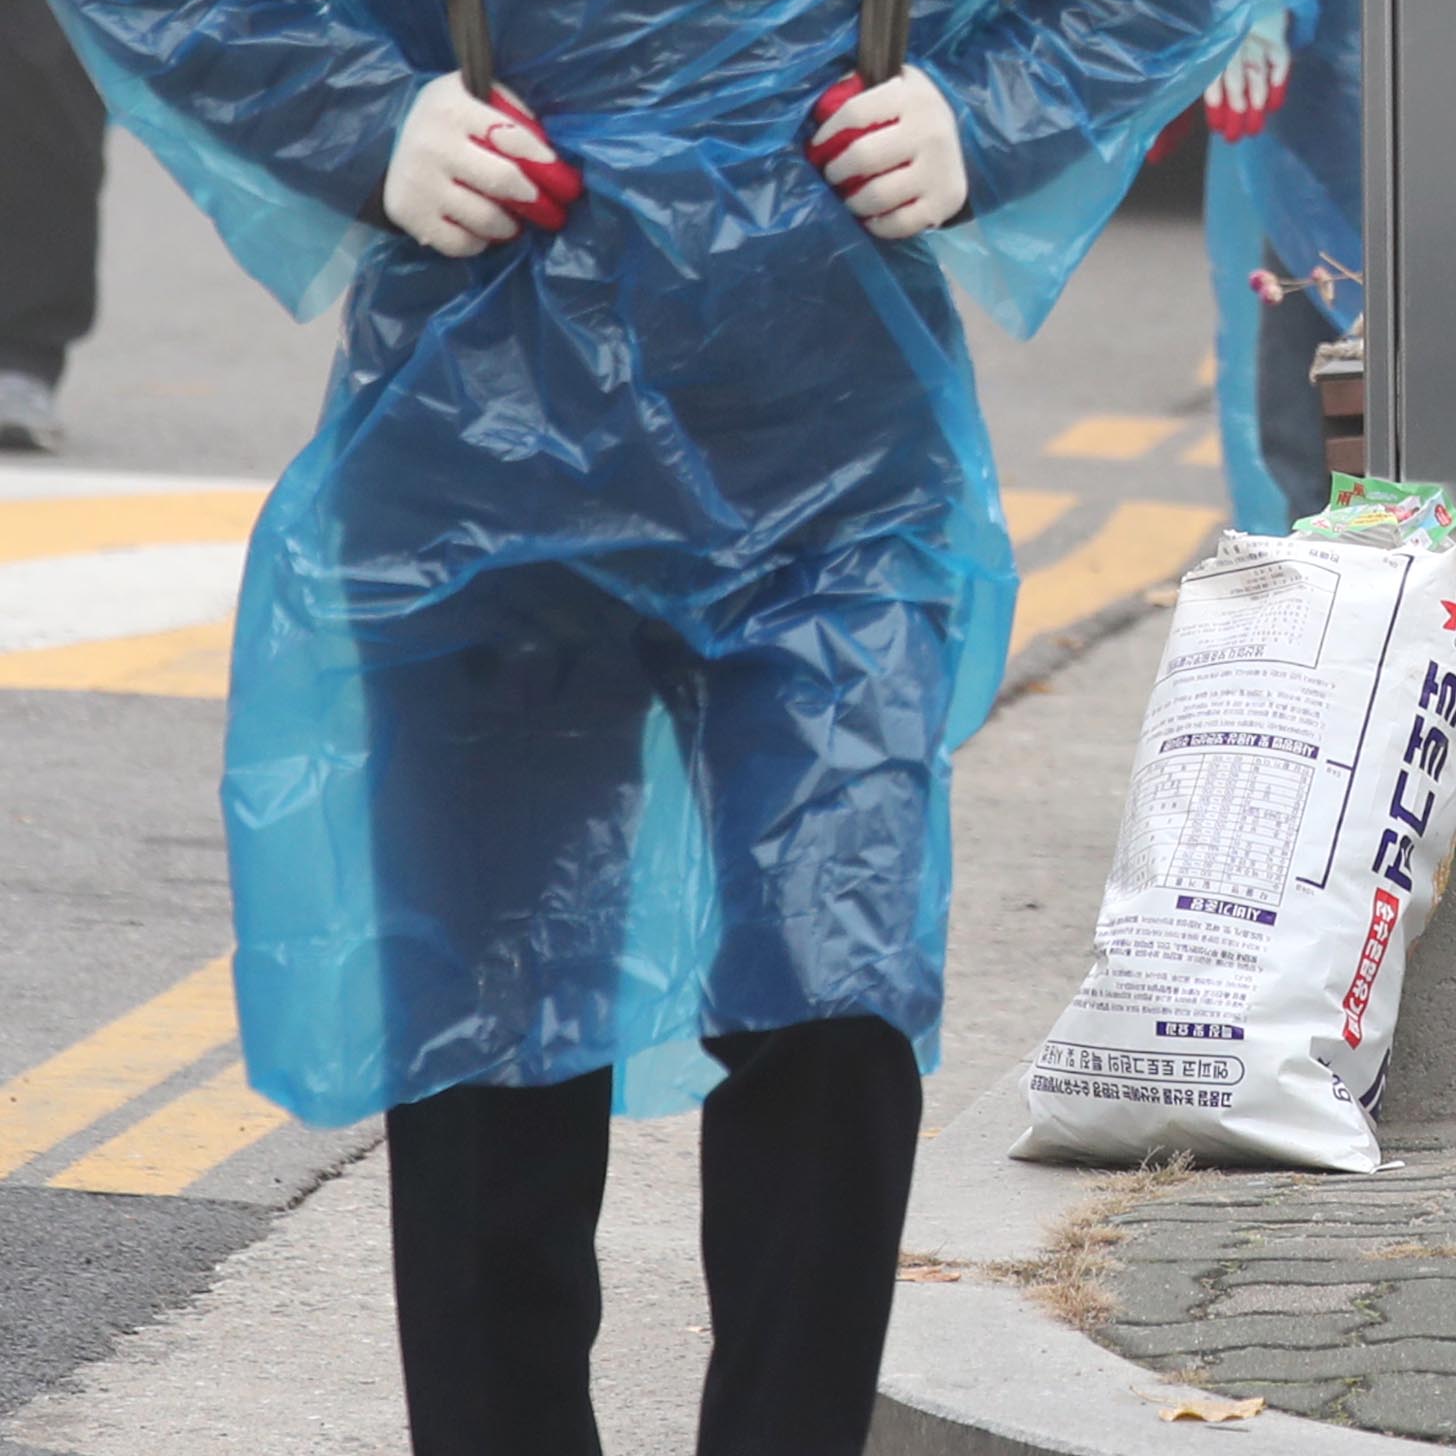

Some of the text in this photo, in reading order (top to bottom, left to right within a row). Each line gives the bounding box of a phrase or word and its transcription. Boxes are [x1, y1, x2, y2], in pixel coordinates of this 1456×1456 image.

[1190, 898, 1260, 922] 시비기준량
[1080, 1051, 1103, 1070] 특징
[1107, 1055, 1175, 1076] 토토그린의
[1182, 1061, 1228, 1080] 엔피코
[1163, 1088, 1194, 1106] 농산물
[1198, 1090, 1233, 1108] 고품질
